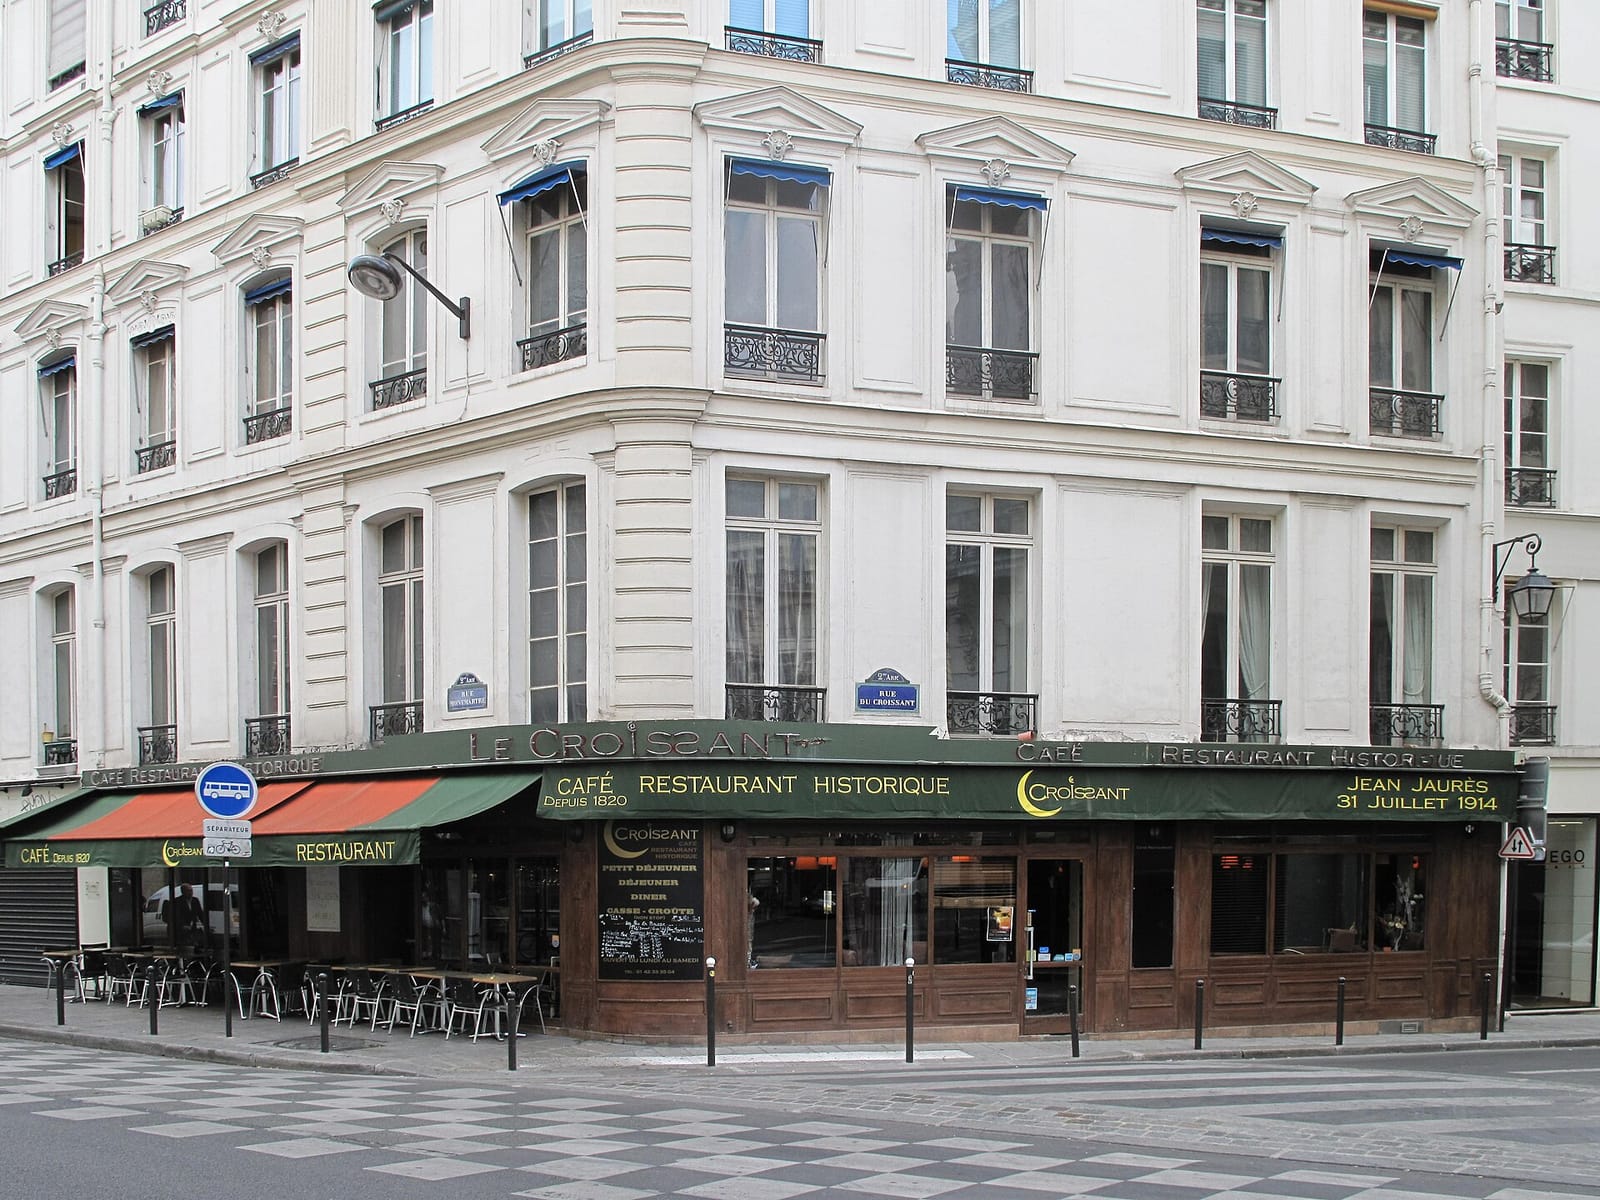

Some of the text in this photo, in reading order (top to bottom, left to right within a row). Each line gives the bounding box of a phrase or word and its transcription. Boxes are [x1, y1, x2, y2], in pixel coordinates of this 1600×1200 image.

[469, 733, 513, 761] LE
[1161, 745, 1465, 769] RESTAURANT HISTORUE
[129, 766, 204, 784] RESTAURA
[244, 757, 321, 775] STORIQUE
[557, 770, 950, 796] CAFÉ RESTAURANT HISTORIQUE
[1346, 776, 1489, 793] JEAN JAURÈS
[543, 795, 628, 808] DEPUIS 1820
[1336, 794, 1498, 811] 31 JUILLET 1914
[20, 844, 91, 863] CAFÉ DEPUIS 1820
[296, 841, 396, 862] RESTAURANT
[636, 864, 697, 872] DÉJEUNER
[618, 879, 679, 887] DÉJEUNER
[607, 907, 641, 915] CASSE
